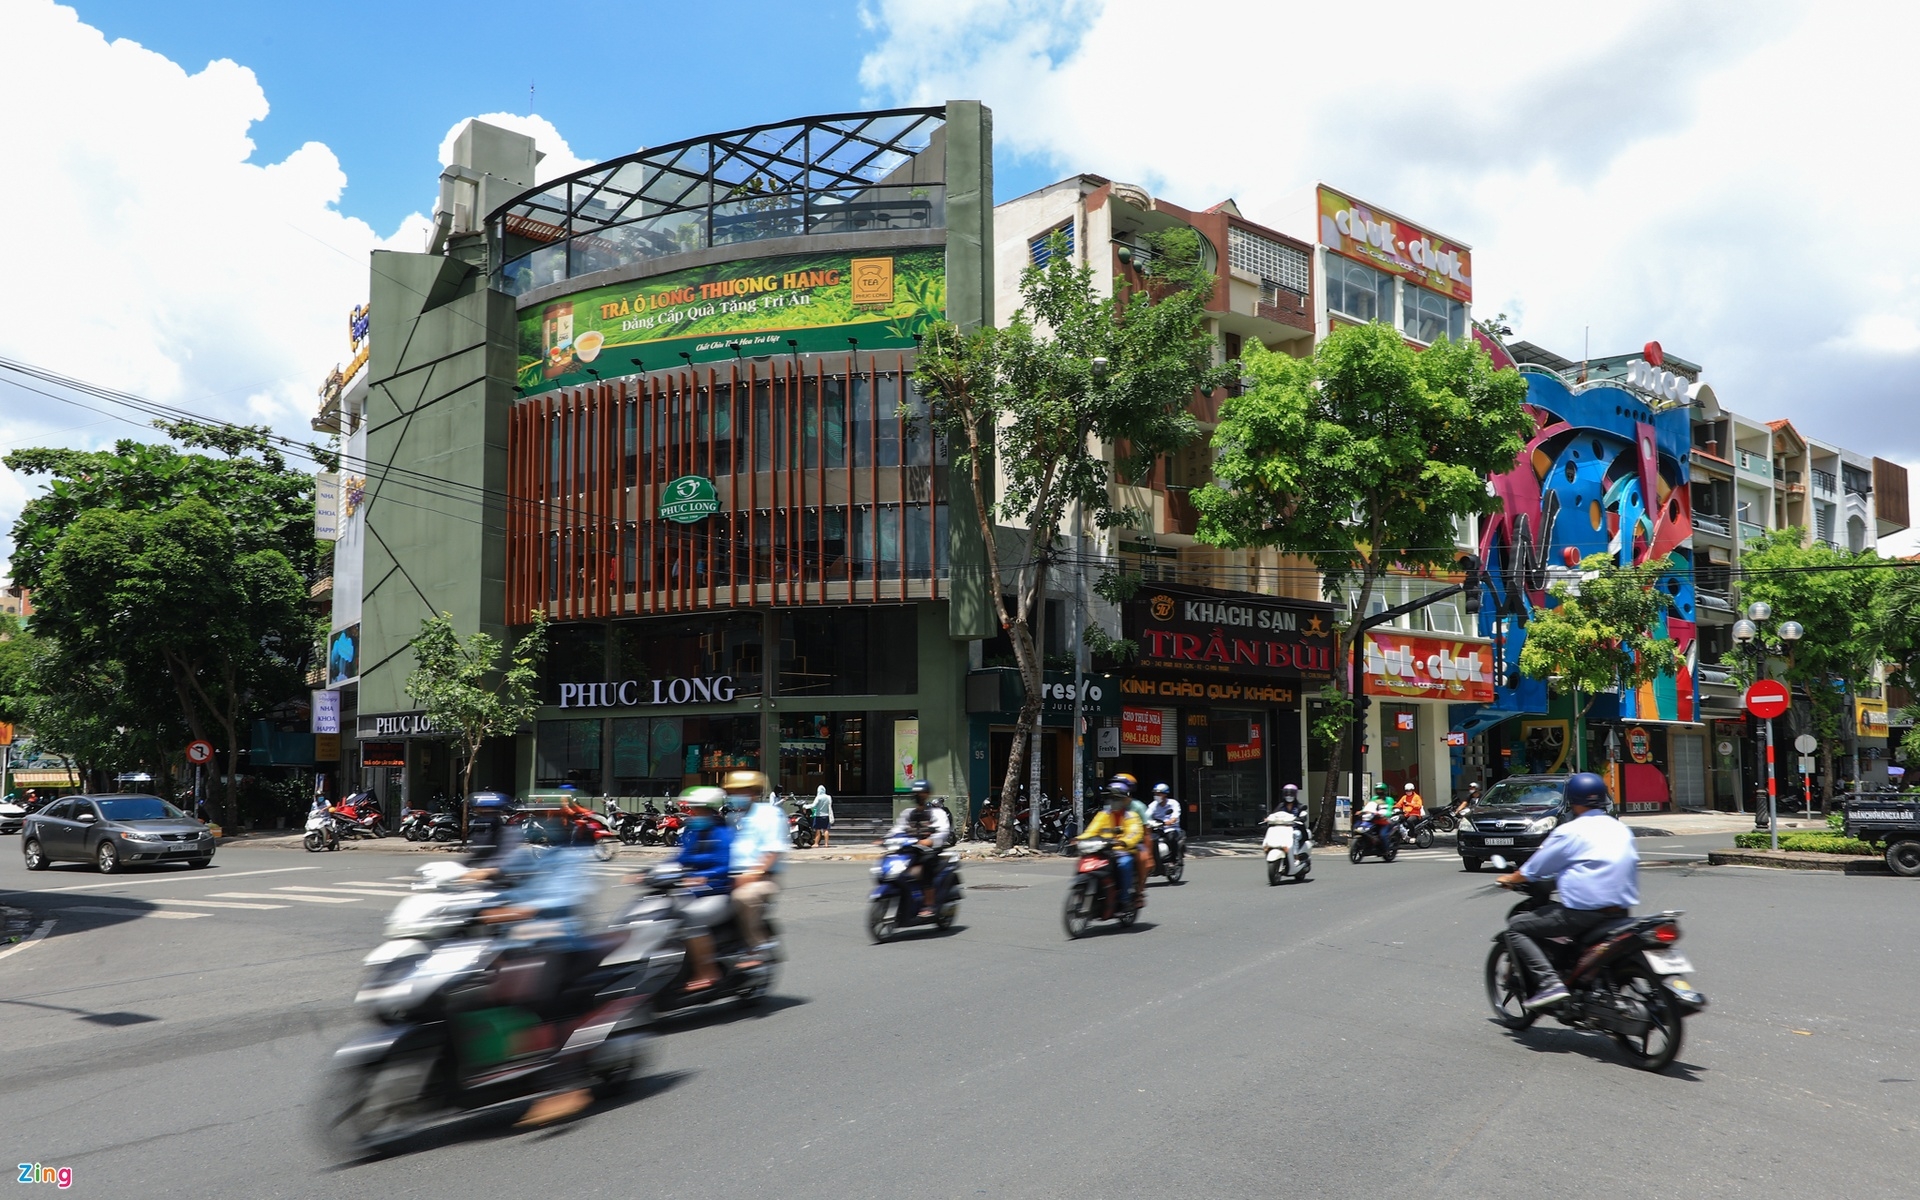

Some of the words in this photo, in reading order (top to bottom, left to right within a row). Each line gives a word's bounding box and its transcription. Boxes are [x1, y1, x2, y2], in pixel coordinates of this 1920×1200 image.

[1369, 250, 1395, 265] CREAM
[1400, 262, 1427, 278] COFFEE
[600, 297, 630, 320] TRÀ
[634, 294, 646, 313] Ô
[650, 286, 695, 310] LONG
[700, 275, 777, 299] THƯỢNG
[783, 269, 840, 292] HẠNG
[658, 306, 684, 325] Cấp
[687, 303, 715, 321] Quà
[719, 299, 757, 315] Tặng
[761, 295, 783, 308] Tri
[788, 291, 810, 306] Ân
[1627, 341, 1690, 404] nice
[661, 504, 687, 516] PHUC
[690, 502, 716, 511] LONG
[1184, 601, 1253, 627] KHÁCH
[1257, 610, 1296, 634] SẠN
[1143, 627, 1261, 668] TRẦN
[1265, 639, 1332, 671] BÙI
[559, 680, 637, 708] PHUC
[651, 675, 736, 705] LONG
[1041, 679, 1102, 701] resYo
[1120, 675, 1155, 694] KÍNH
[1159, 678, 1204, 697] CHÀO
[1207, 681, 1241, 699] QUÝ
[1244, 684, 1292, 702] KHÁCH
[1418, 682, 1446, 690] COFFEE
[1052, 703, 1073, 711] JUIC
[1123, 711, 1133, 722] CHO
[1135, 712, 1148, 723] THUÊ
[1149, 713, 1160, 724] NHÀ
[376, 715, 410, 734] PHUC
[1188, 715, 1208, 726] HOTEL
[975, 750, 984, 759] 95
